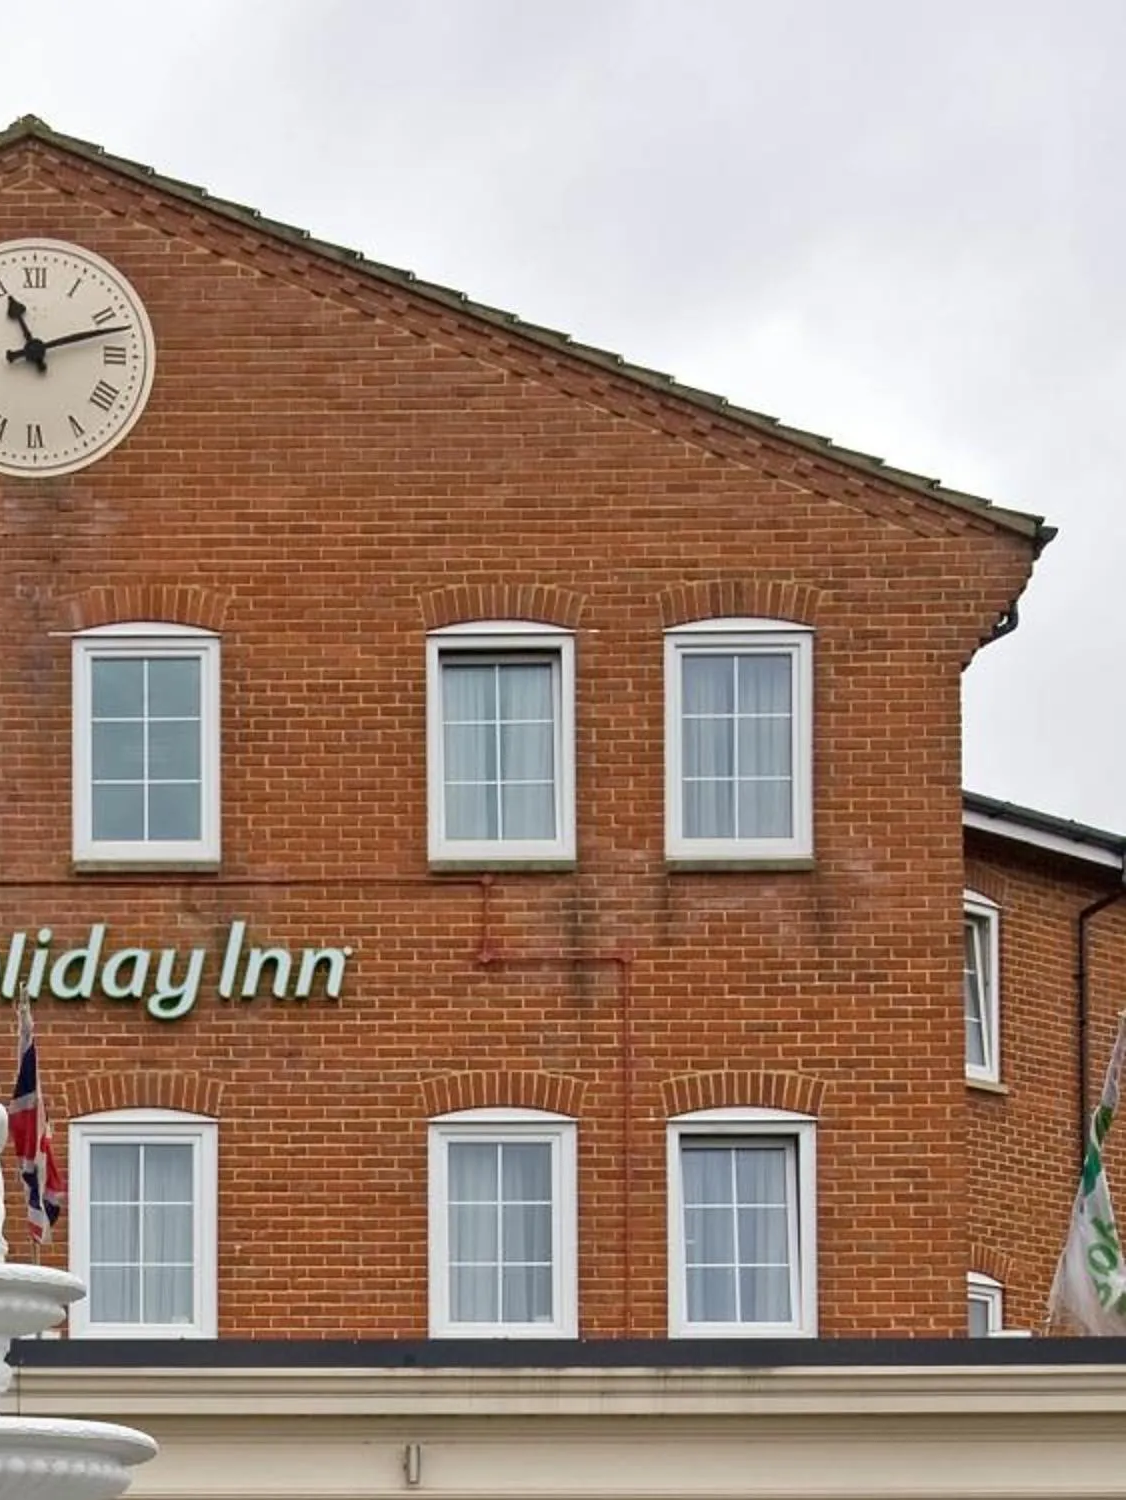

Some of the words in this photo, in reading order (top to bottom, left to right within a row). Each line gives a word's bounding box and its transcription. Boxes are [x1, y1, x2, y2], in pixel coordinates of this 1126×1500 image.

[22, 267, 47, 289] XII
[67, 277, 82, 298] I
[92, 306, 116, 326] II
[103, 346, 127, 366] III
[26, 423, 44, 449] VI
[67, 415, 85, 438] V
[218, 920, 347, 999] Inn
